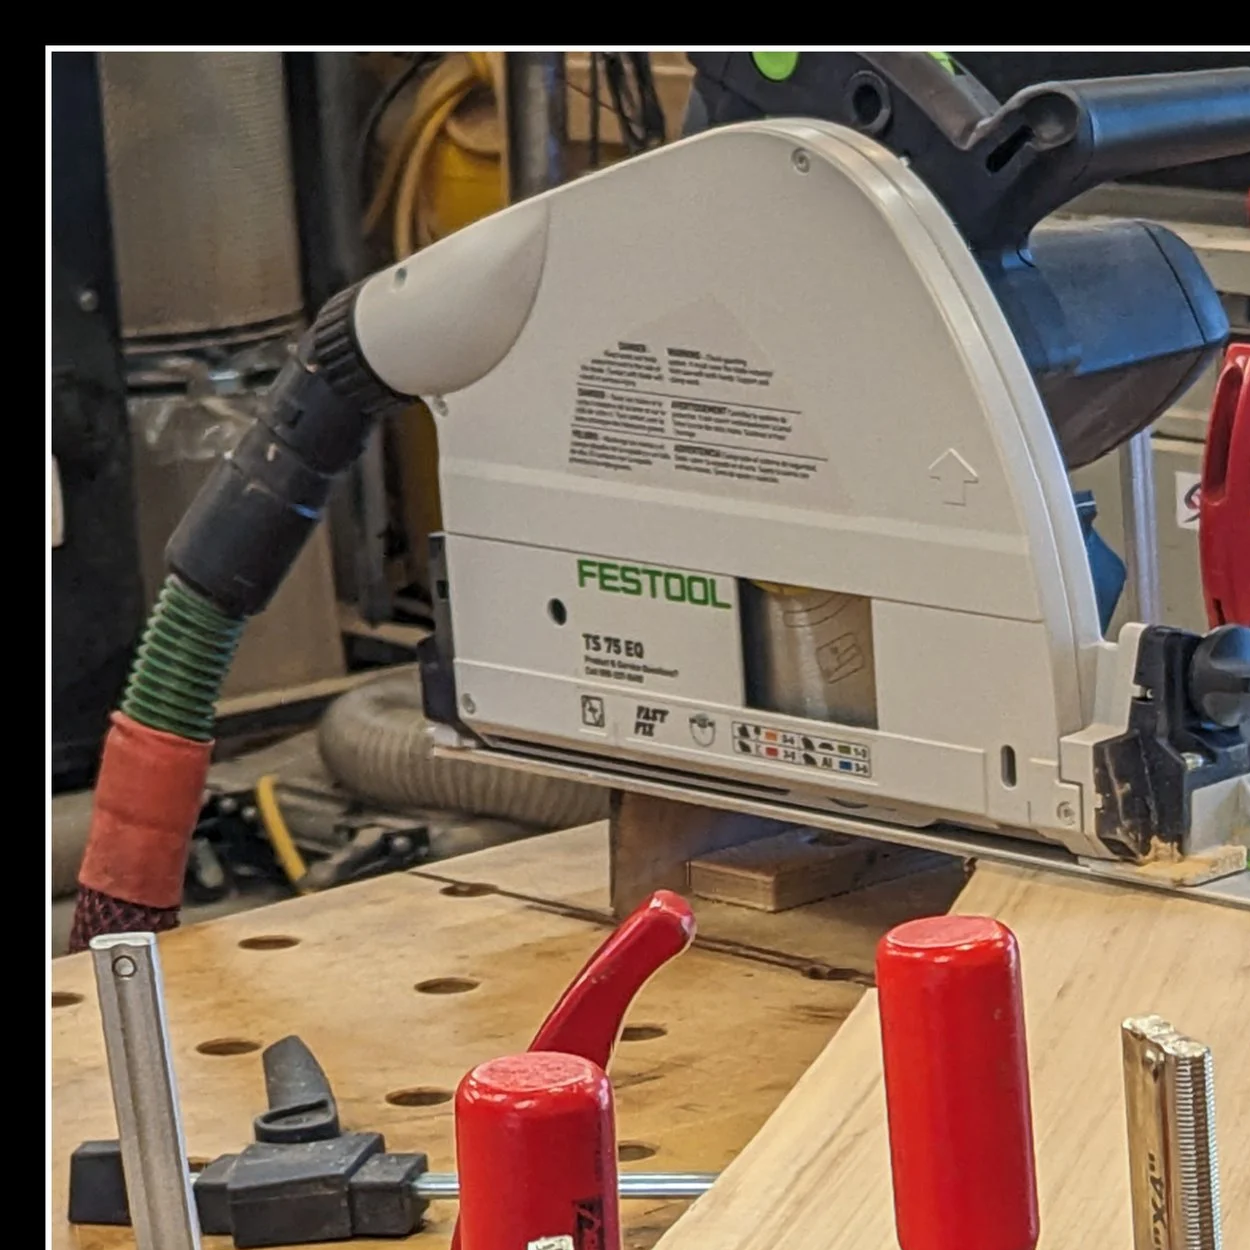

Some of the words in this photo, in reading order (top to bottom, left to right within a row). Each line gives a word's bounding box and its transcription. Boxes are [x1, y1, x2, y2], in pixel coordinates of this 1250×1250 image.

[577, 559, 731, 609] FESTOOL
[582, 632, 601, 652] TS
[603, 636, 622, 655] 75
[624, 639, 645, 659] EQ
[637, 705, 670, 723] FAST
[634, 721, 655, 738] FIX
